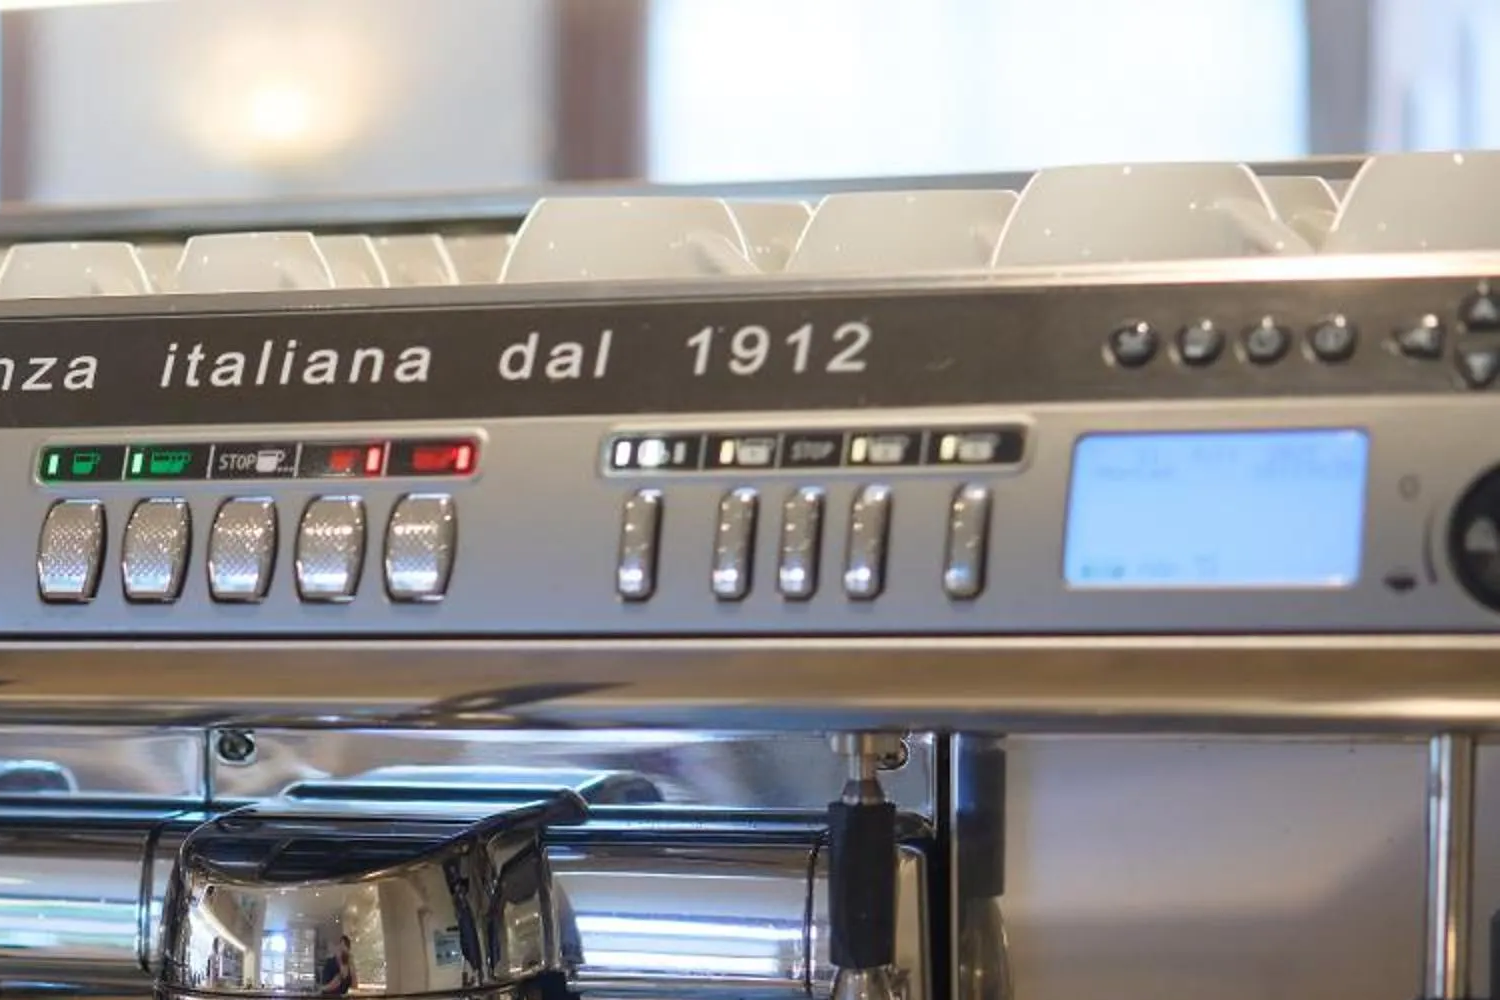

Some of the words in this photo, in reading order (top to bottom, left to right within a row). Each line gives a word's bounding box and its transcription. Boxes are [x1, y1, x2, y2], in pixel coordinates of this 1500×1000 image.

[159, 340, 432, 388] italiana
[499, 330, 613, 381] dal
[686, 322, 872, 376] 1912
[219, 453, 256, 471] STOP
